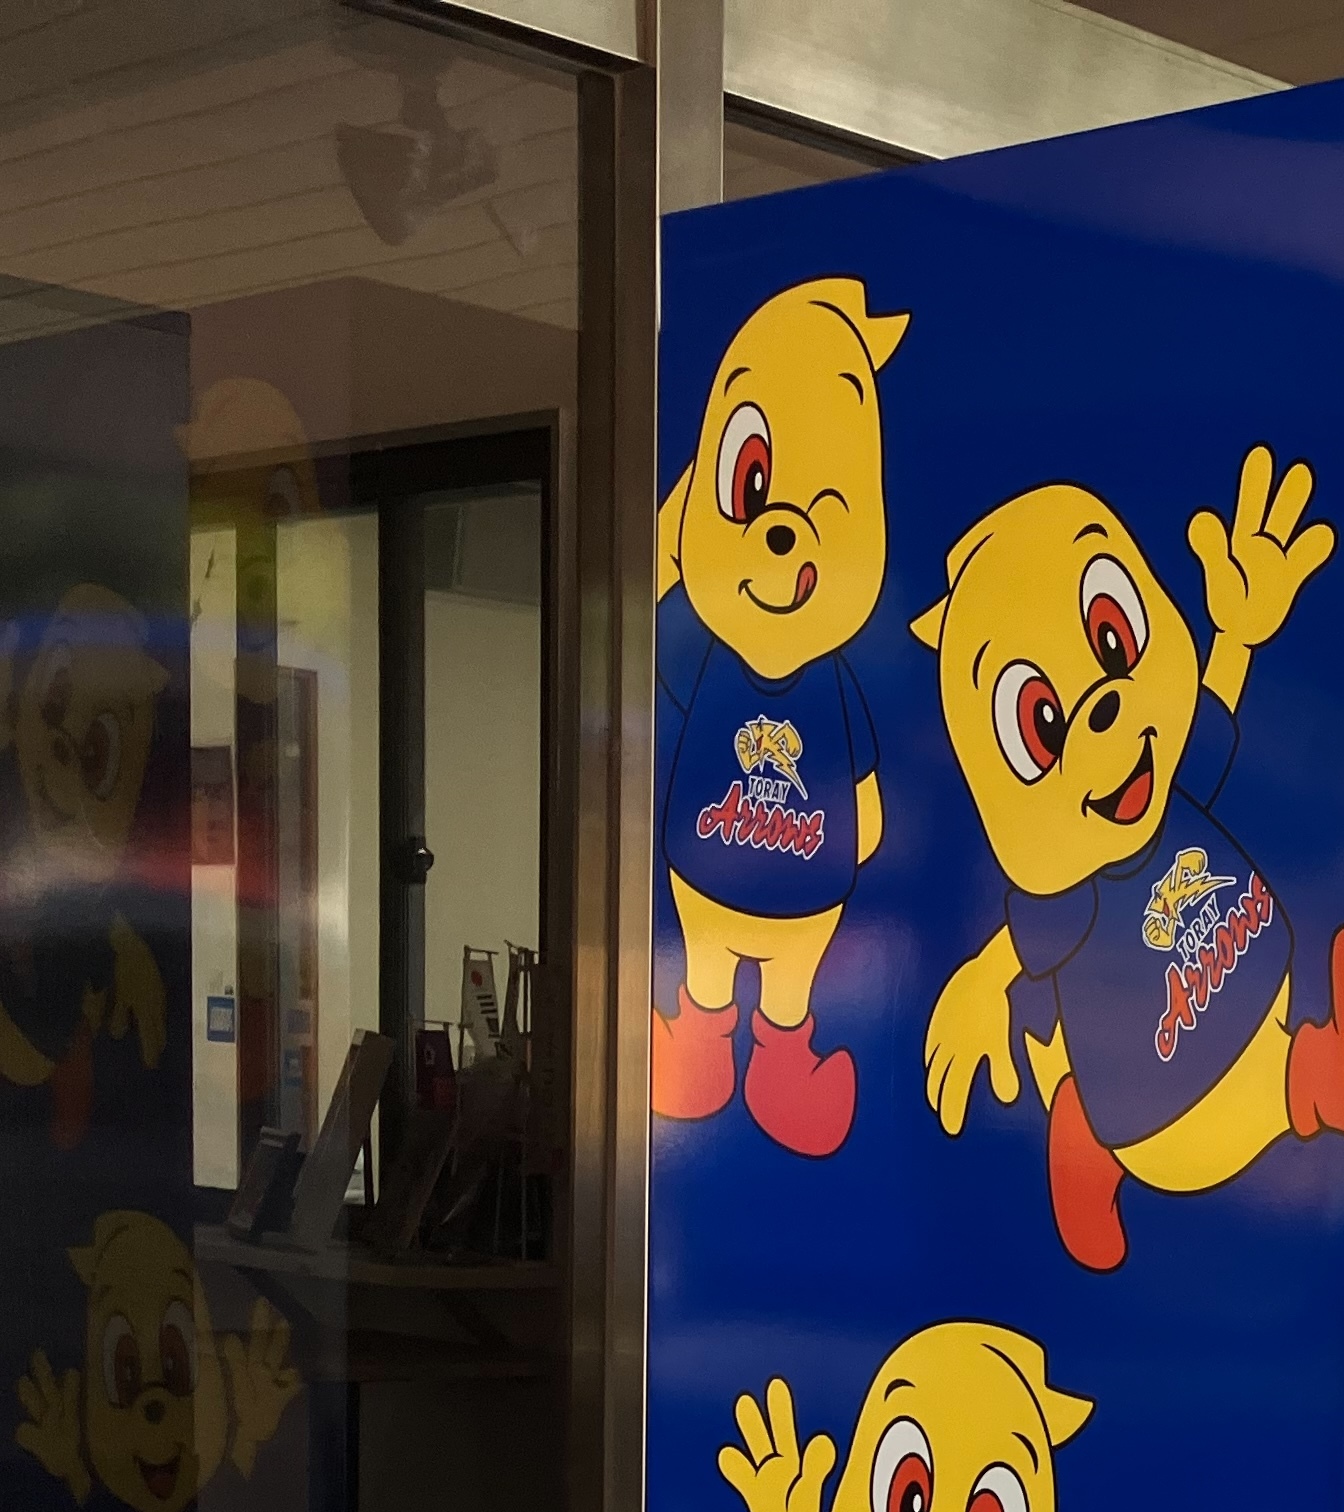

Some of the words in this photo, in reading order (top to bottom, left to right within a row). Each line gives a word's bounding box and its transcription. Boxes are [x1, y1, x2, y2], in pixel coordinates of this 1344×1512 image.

[698, 781, 826, 860] Arrows
[746, 774, 790, 804] TORAY
[1178, 895, 1223, 960] TORAY
[1153, 870, 1275, 1063] Arrows
